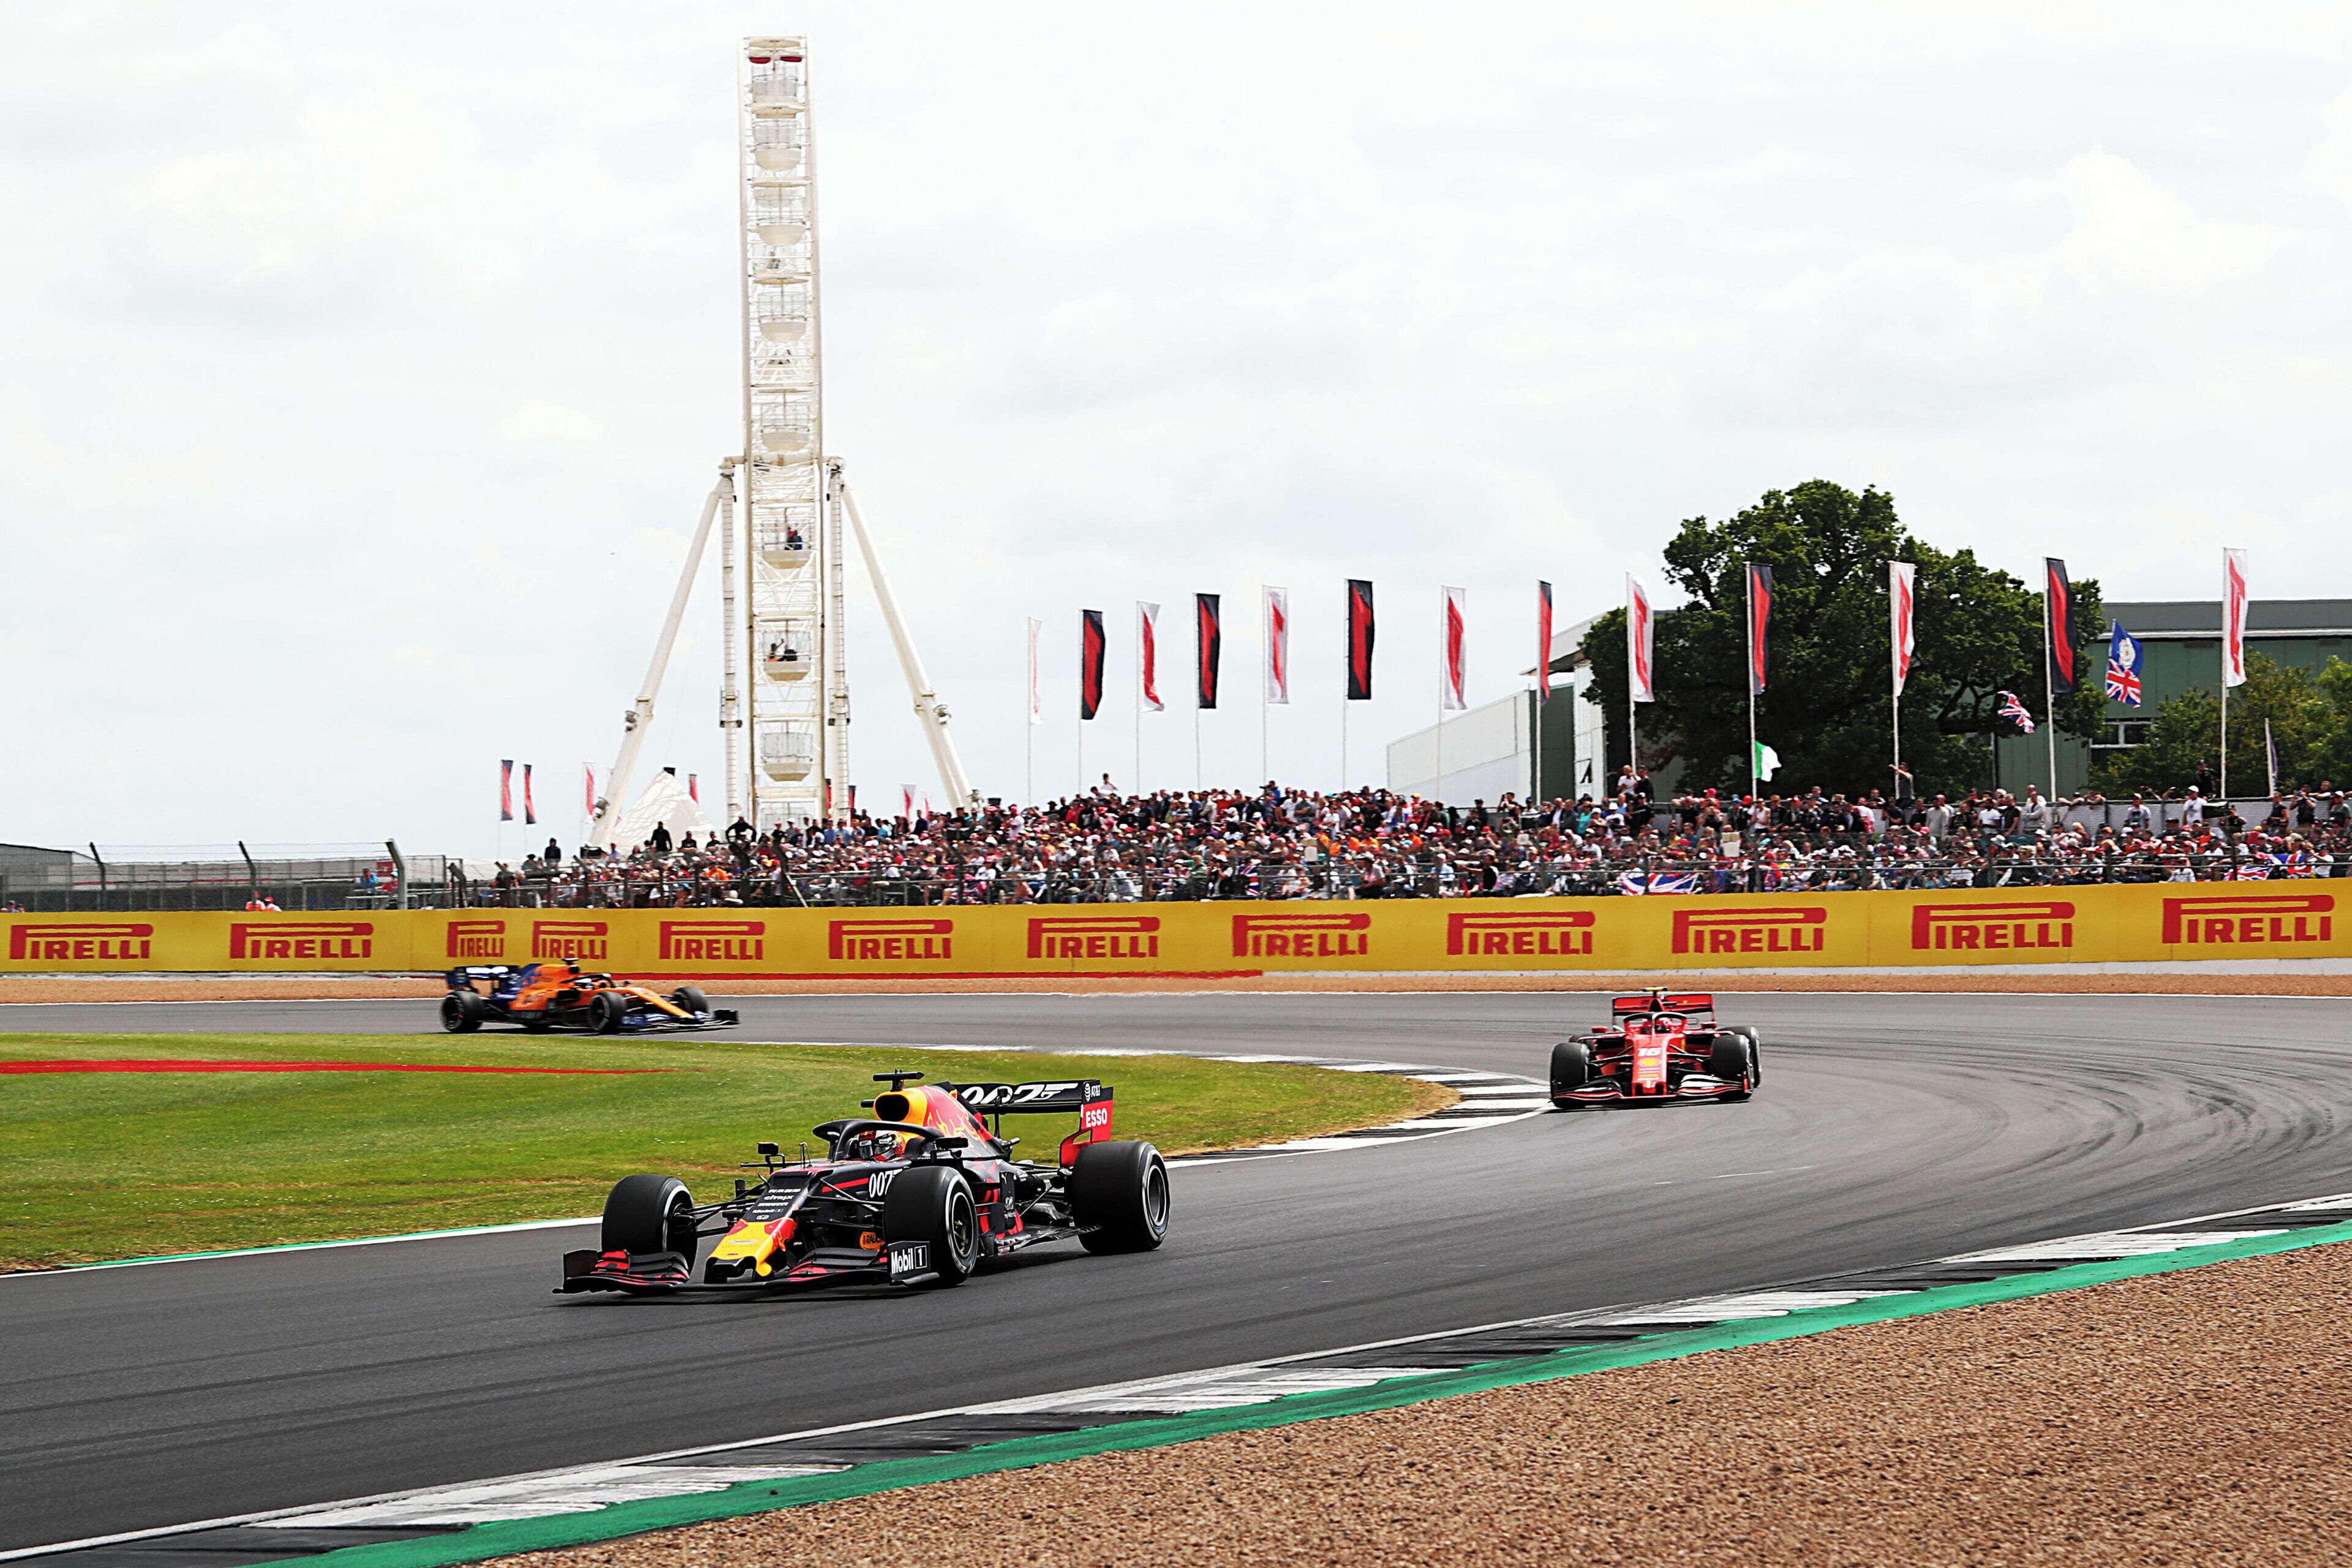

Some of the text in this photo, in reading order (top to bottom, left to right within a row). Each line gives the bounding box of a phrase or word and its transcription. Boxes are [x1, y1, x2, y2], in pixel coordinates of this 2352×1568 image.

[1027, 917, 1160, 958] PIRELLI
[1232, 913, 1371, 957] PIRELLI
[1446, 911, 1596, 955] PIRELLI
[1672, 908, 1827, 954] PIRELLI
[1912, 902, 2075, 949] PIRELLI
[2163, 894, 2335, 943] PIRELLI
[9, 924, 153, 959] PIRELLI
[230, 922, 373, 959] PIRELLI
[447, 921, 505, 957] PIRELLI
[532, 921, 608, 959] PIRELLI
[660, 921, 765, 960] PIRELLI
[829, 919, 953, 959] PIRELLI
[1637, 1048, 1661, 1057] 16
[1091, 1085, 1101, 1097] AT&T
[1085, 1107, 1108, 1128] ESSO
[869, 1169, 900, 1198] 007
[891, 1248, 914, 1274] Mobil
